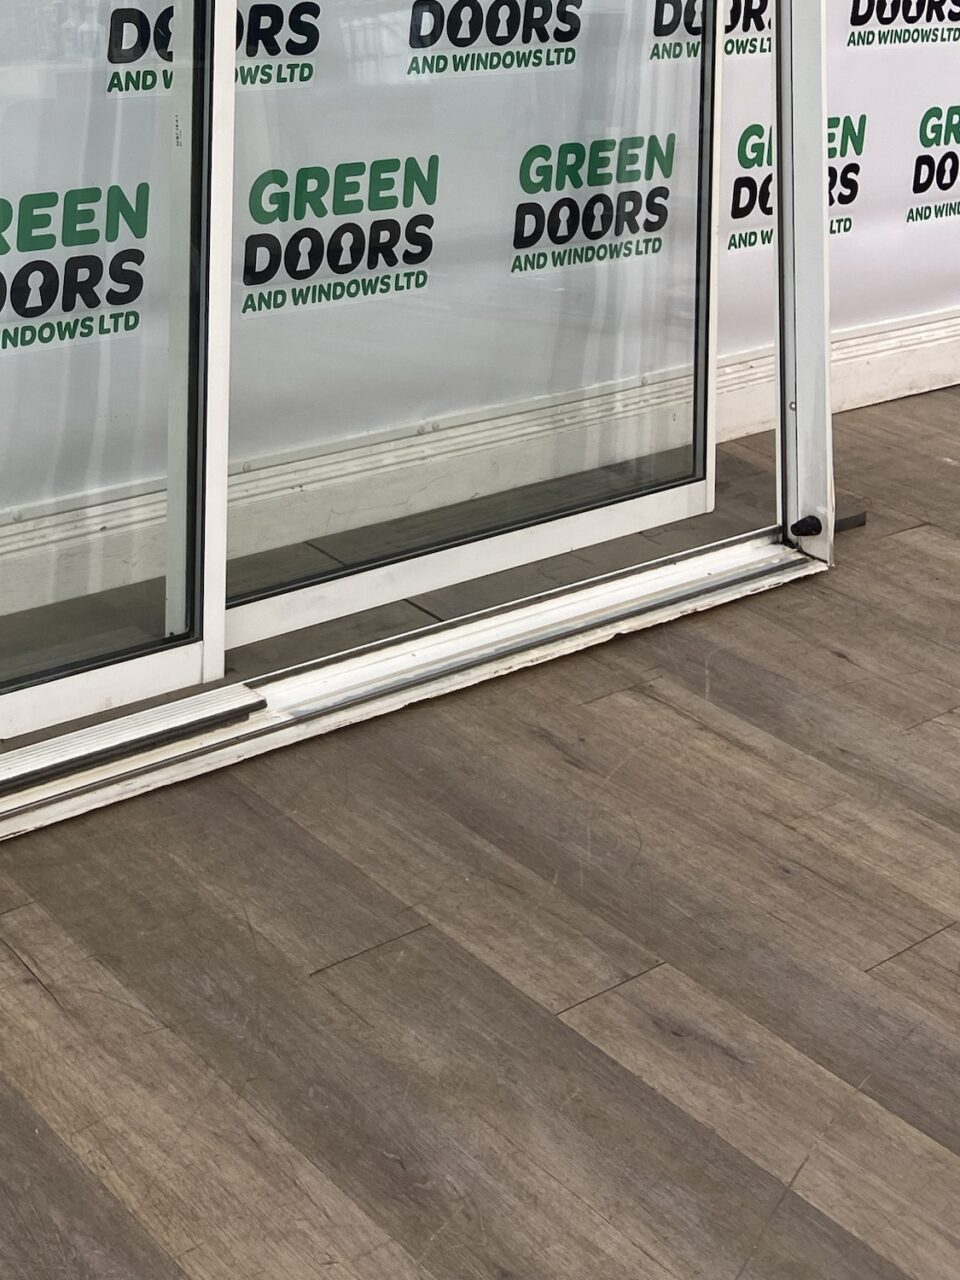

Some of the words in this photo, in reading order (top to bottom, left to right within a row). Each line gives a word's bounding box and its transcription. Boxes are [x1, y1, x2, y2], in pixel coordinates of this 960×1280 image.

[650, 43, 683, 60] AND
[847, 31, 875, 47] AND
[878, 28, 939, 45] WINDOWS
[407, 55, 448, 75] AND
[452, 49, 543, 72] WINDOWS
[546, 46, 576, 66] LTD
[107, 70, 157, 92] AND
[277, 63, 313, 83] LTD
[520, 133, 676, 194] GREEN
[249, 154, 439, 224] GREEN
[513, 187, 669, 249] DOORS
[907, 207, 932, 222] AND
[243, 214, 434, 286] DOORS
[728, 231, 757, 250] AND
[830, 218, 852, 234] LTD
[511, 251, 548, 273] AND
[552, 240, 632, 267] WINDOWS
[635, 237, 662, 256] LTD
[242, 290, 286, 313] AND
[292, 274, 391, 306] WINDOWS
[395, 270, 427, 292] LTD
[98, 310, 139, 333] LTD
